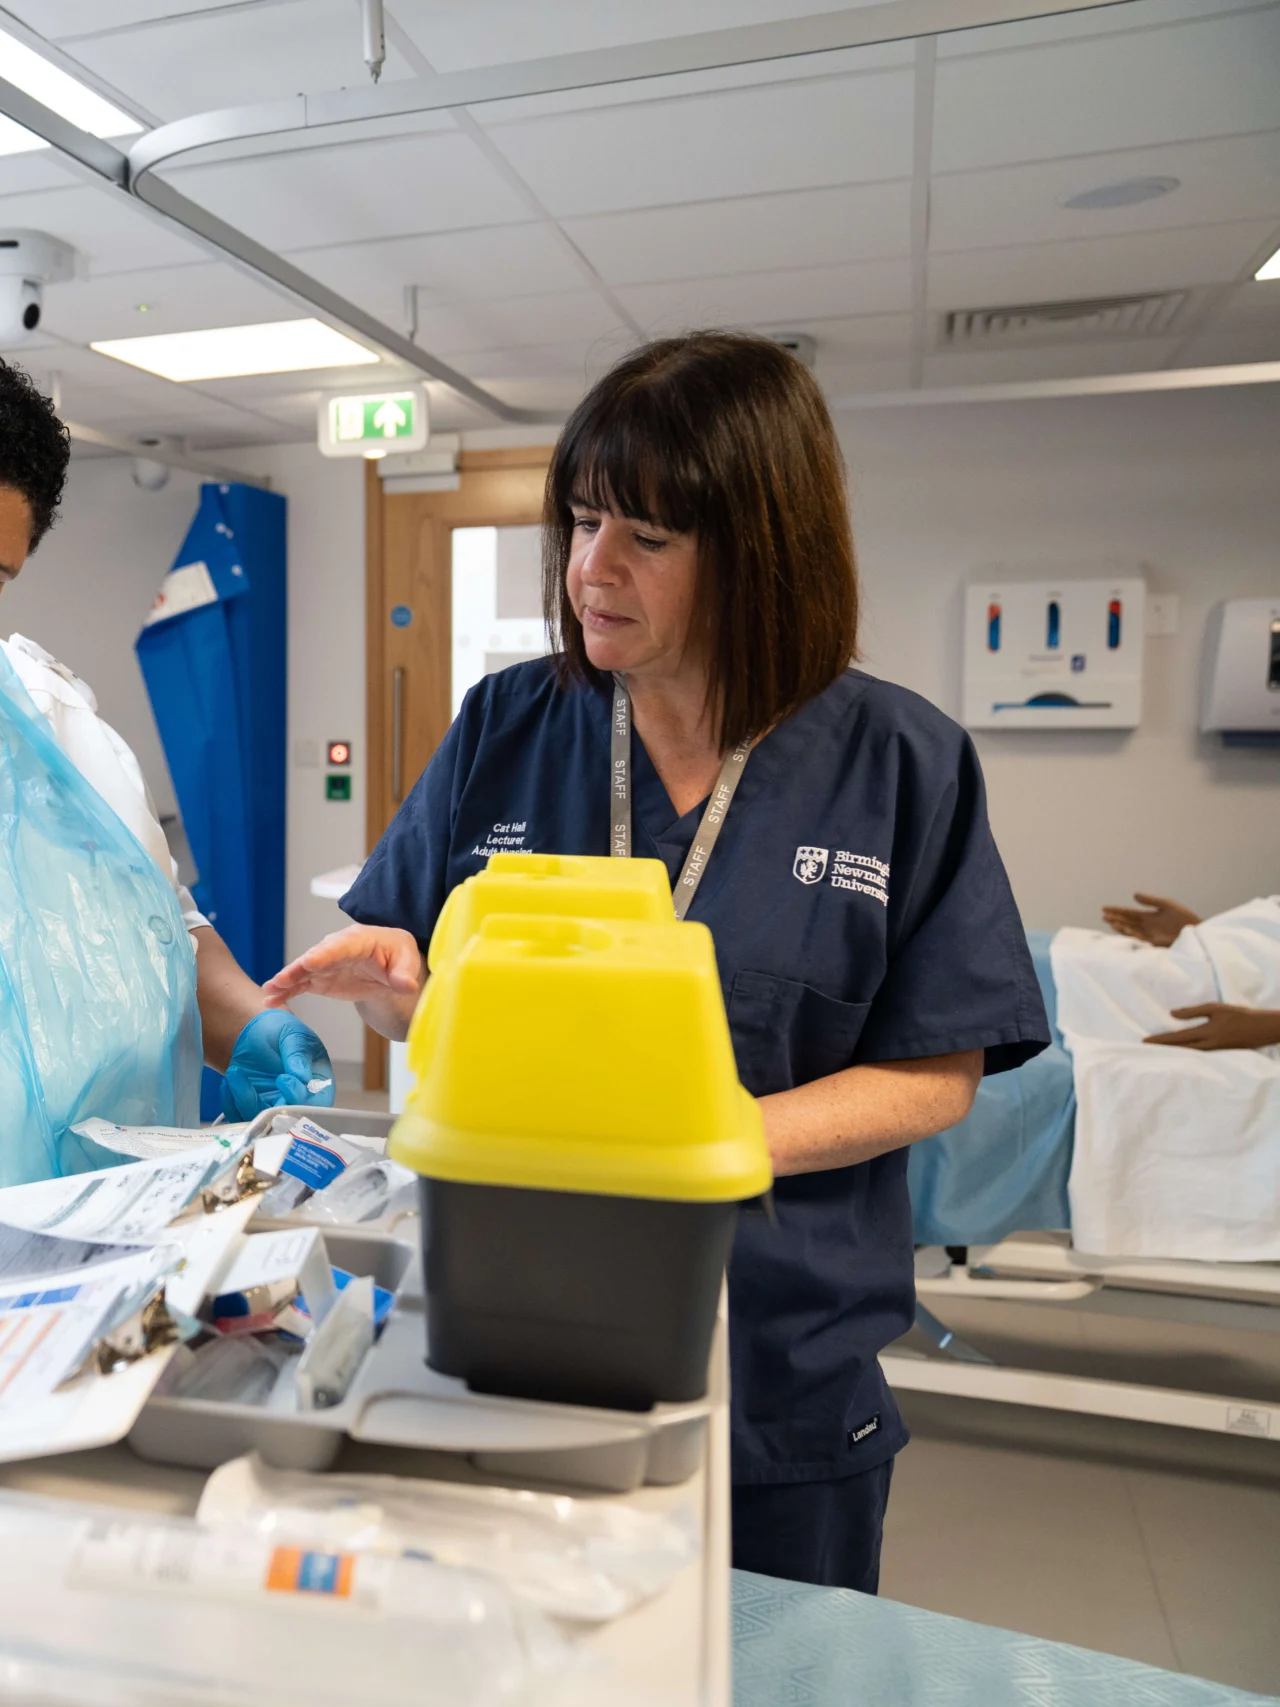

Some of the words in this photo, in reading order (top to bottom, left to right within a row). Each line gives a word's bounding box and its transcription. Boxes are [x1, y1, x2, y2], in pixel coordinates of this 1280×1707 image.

[616, 698, 626, 736] STAFF
[614, 760, 626, 800] STAFF
[708, 784, 731, 824] STAFF
[486, 834, 525, 844] Lecturer
[493, 823, 510, 833] Cat
[511, 821, 527, 832] Hall
[471, 845, 497, 857] Adult
[614, 824, 626, 858] STAF
[683, 845, 706, 886] STAFF
[832, 863, 886, 888] Newman
[303, 1124, 329, 1141] clinell
[853, 1422, 877, 1441] Landau
